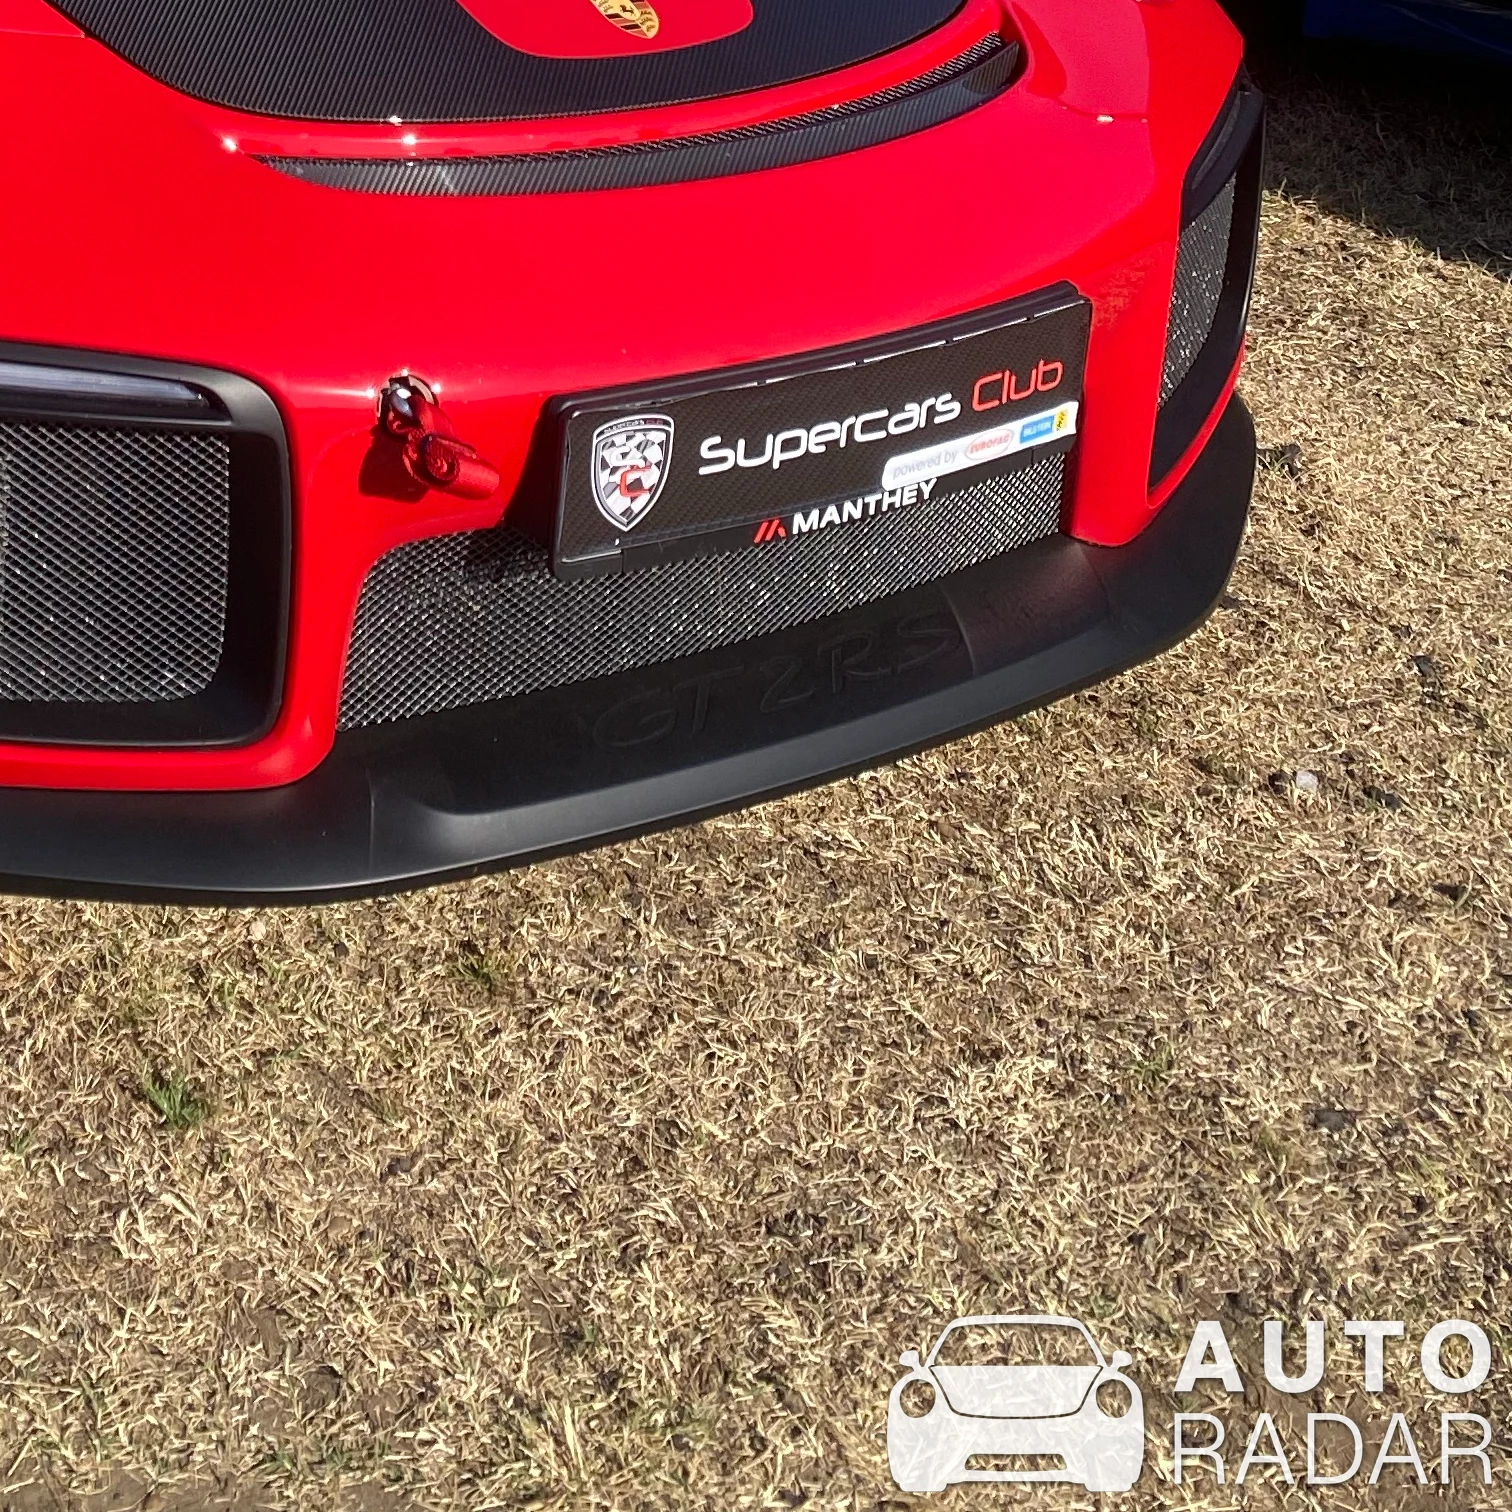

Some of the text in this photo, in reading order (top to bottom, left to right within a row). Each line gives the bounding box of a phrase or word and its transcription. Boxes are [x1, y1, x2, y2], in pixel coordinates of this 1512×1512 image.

[699, 359, 1063, 475] Supercars Club
[893, 448, 958, 480] powered by
[791, 477, 938, 535] MANTHEY
